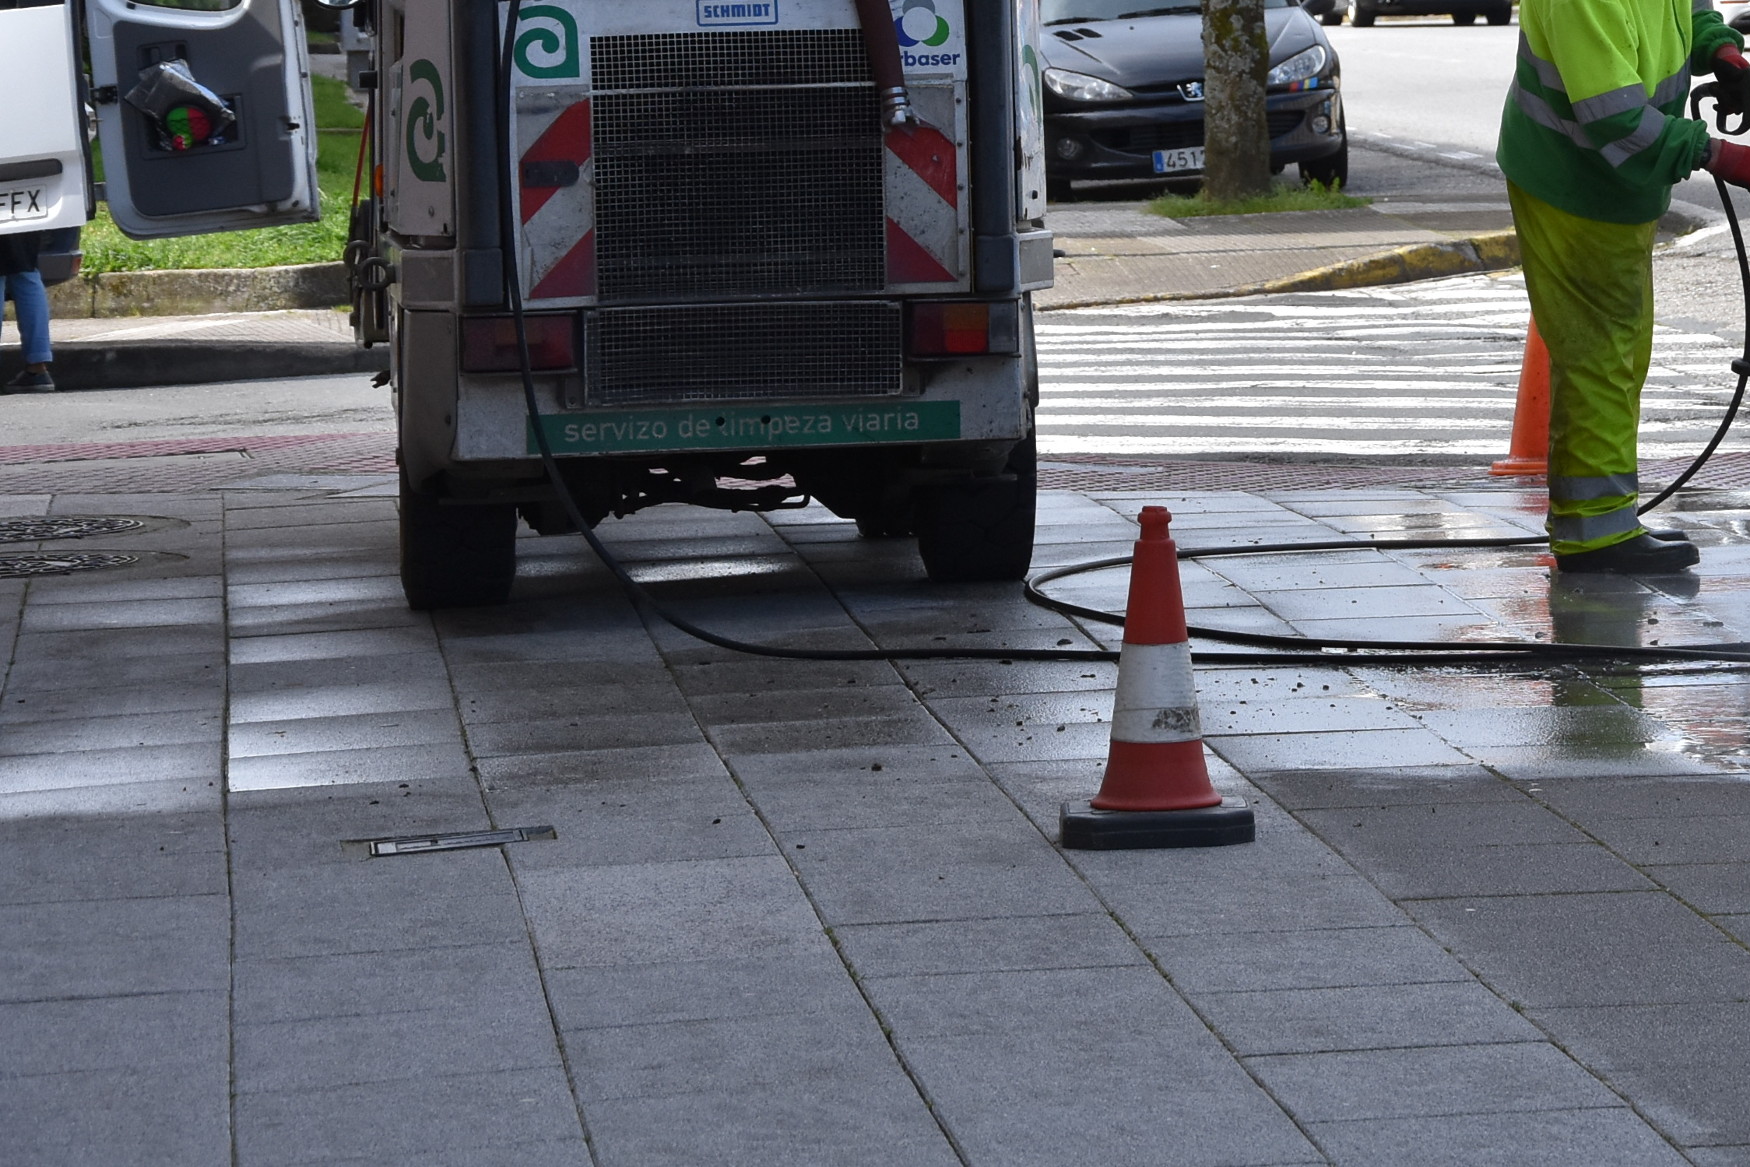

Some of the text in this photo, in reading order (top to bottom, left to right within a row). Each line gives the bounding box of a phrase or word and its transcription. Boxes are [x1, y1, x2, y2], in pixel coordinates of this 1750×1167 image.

[703, 3, 771, 19] SCHMIDT
[564, 408, 919, 442] servizo de limpeza viaria
